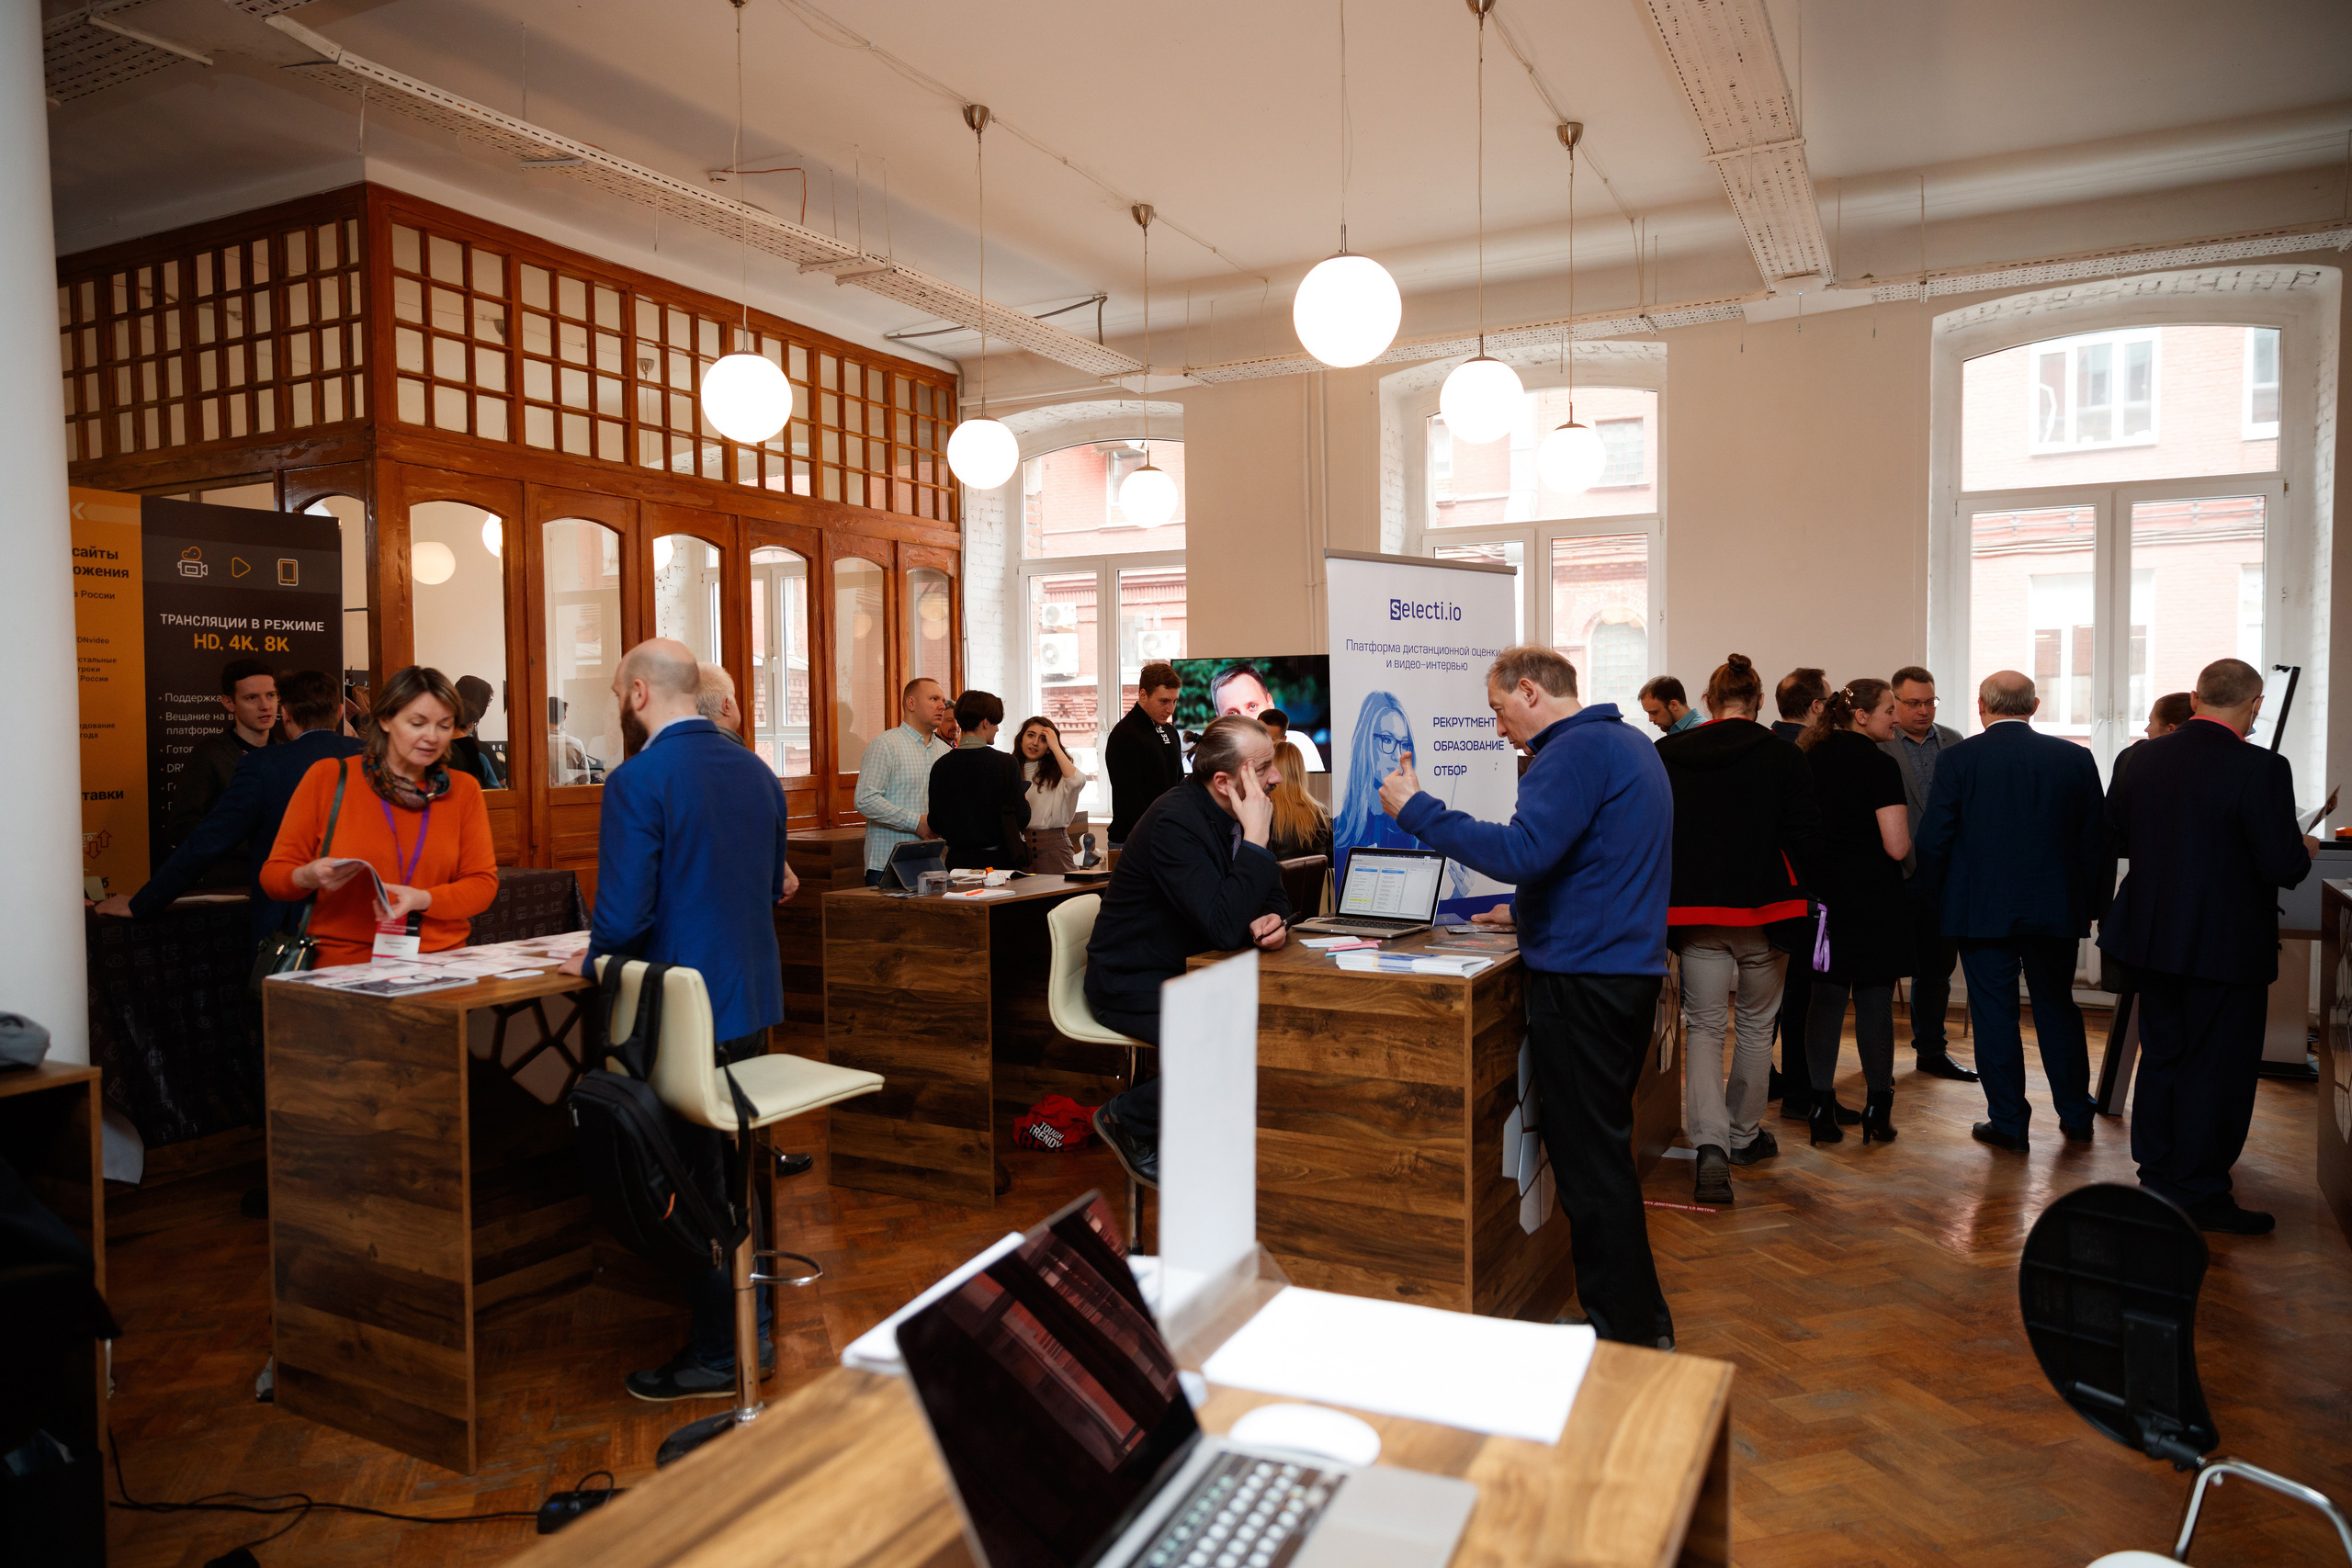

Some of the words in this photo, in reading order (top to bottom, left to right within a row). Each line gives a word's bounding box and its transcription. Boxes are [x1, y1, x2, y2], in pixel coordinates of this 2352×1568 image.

[73, 566, 129, 578] ожения
[81, 590, 115, 600] России
[1390, 599, 1462, 621] Selecti.io
[160, 614, 247, 630] ТРАНСЛЯЦИИ
[252, 618, 260, 629] В
[265, 619, 324, 632] РЕЖИМЕ
[194, 633, 223, 651] HD,
[229, 635, 259, 652] 4K,
[265, 636, 289, 652] 8K
[1346, 639, 1401, 655] Платформа
[1403, 644, 1470, 657] дистанционной
[1472, 647, 1501, 658] оценки
[1385, 660, 1392, 668] и
[1395, 660, 1468, 673] видео-интервью
[164, 694, 221, 704] Поддержка
[165, 712, 210, 722] Вещание
[1433, 716, 1497, 728] РЕКРУТМЕНТ
[166, 727, 223, 736] платформы
[166, 745, 194, 753] Гото
[1434, 740, 1504, 750] ОБРАЗОВАНИЕ
[167, 763, 184, 773] DR
[1434, 765, 1467, 776] ОТБОР
[82, 790, 123, 800] тавки
[1029, 1123, 1063, 1148] TRENDY
[1039, 1122, 1065, 1140] TOUGH
